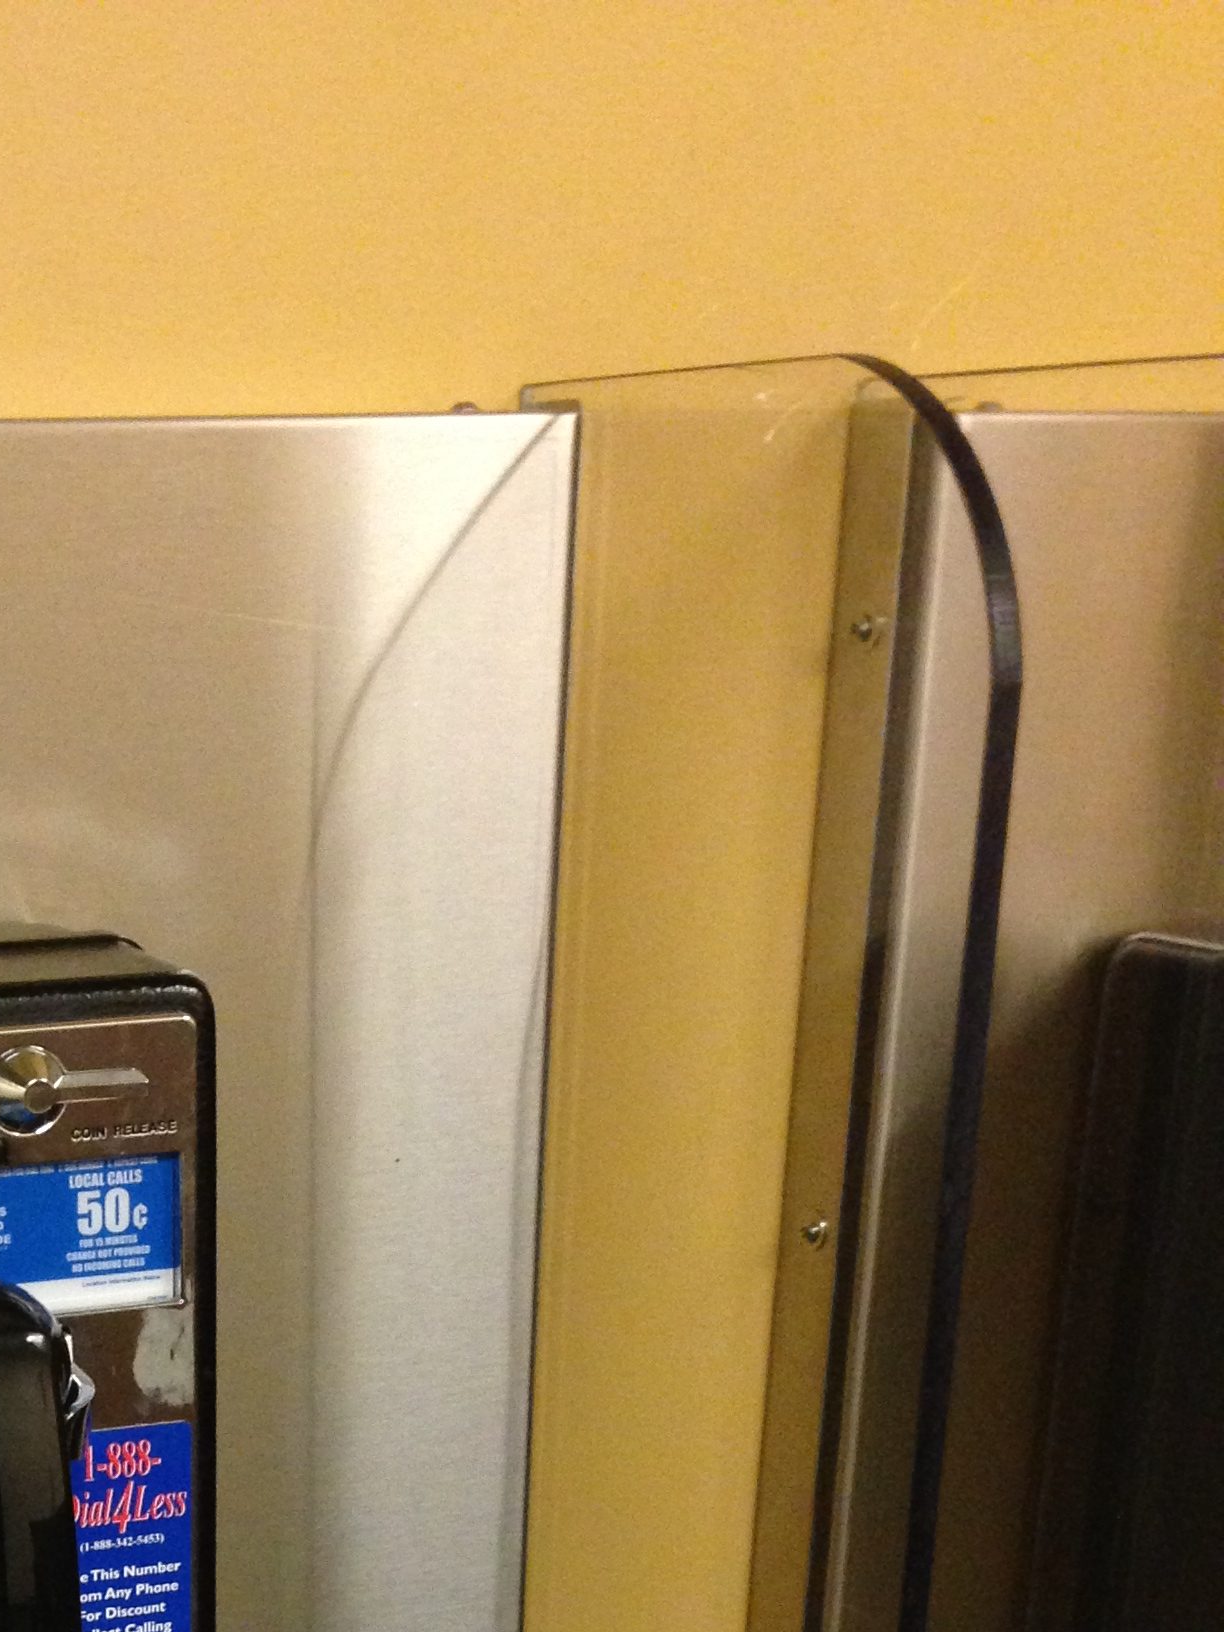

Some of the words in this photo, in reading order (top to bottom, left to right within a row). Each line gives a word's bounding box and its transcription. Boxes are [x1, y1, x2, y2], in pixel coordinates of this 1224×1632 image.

[71, 1128, 106, 1142] COIN
[113, 1121, 177, 1138] RELEASE
[69, 1172, 105, 1188] LOCAL
[107, 1169, 143, 1185] CALLS
[84, 1439, 162, 1482] 1-888-
[90, 1568, 120, 1582] This
[123, 1561, 182, 1578] Number
[79, 1592, 102, 1603] om
[104, 1587, 133, 1600] Any
[135, 1582, 179, 1596] Phone
[105, 1602, 167, 1620] Discount
